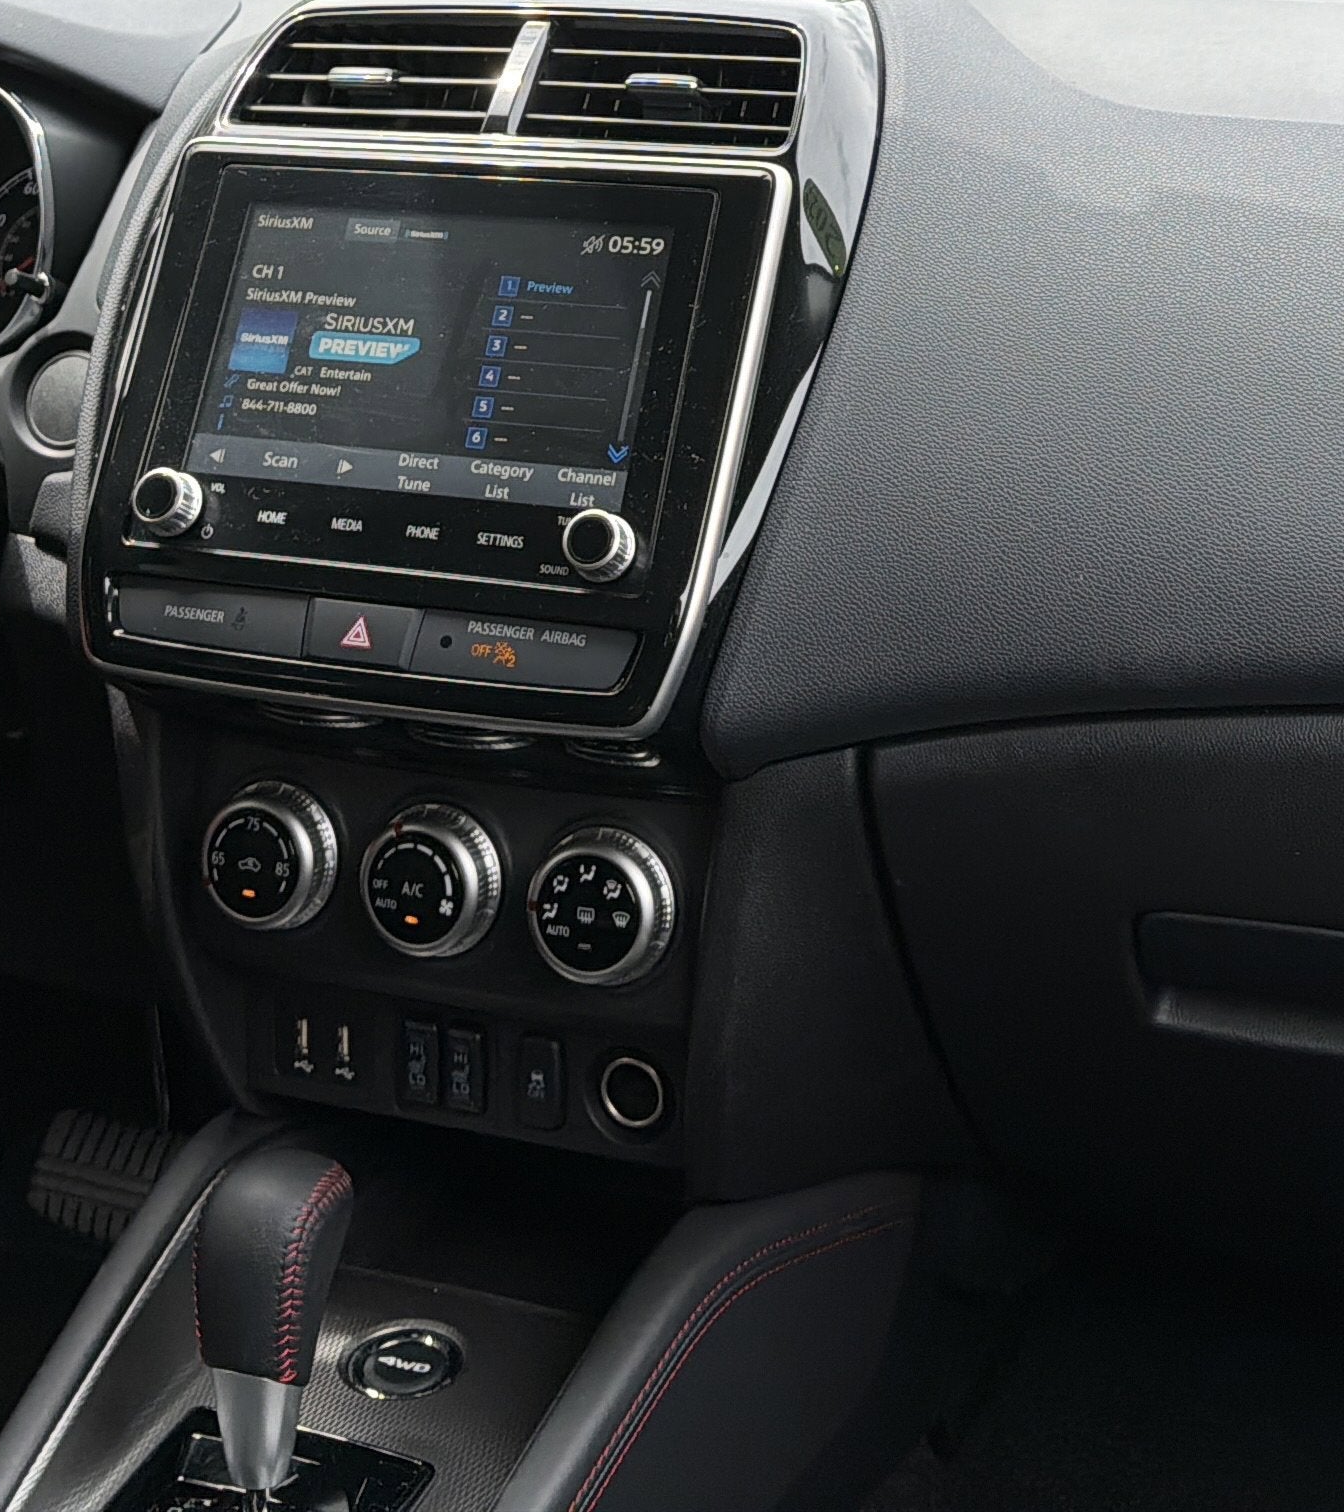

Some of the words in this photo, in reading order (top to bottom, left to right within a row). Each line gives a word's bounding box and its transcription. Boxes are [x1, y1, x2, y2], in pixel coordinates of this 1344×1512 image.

[258, 214, 314, 230] SiriusXM
[353, 223, 392, 236] Source
[608, 236, 665, 255] 05:59
[252, 264, 274, 279] CH
[276, 265, 285, 280] 1
[527, 281, 574, 295] Preview
[246, 287, 303, 304] SiriusXM
[305, 291, 357, 308] Preview
[324, 312, 415, 335] SIRIUSXM
[240, 332, 289, 345] SiriusXM
[318, 338, 411, 359] PREVIEW
[294, 365, 314, 377] CAT
[320, 367, 372, 382] Entertain
[247, 378, 277, 392] Great
[279, 381, 309, 395] Offer
[310, 383, 342, 397] Now!
[241, 398, 317, 416] 844-711-8800
[263, 451, 298, 469] Scan
[398, 454, 440, 470] Direct
[470, 460, 534, 481] Category
[558, 468, 617, 487] Channel
[210, 482, 226, 494] VOL
[397, 476, 431, 492] Tune
[485, 484, 510, 500] List
[569, 492, 595, 508] List
[257, 509, 288, 525] HOME
[331, 516, 363, 532] MEDIA
[406, 524, 440, 540] PHONE
[476, 531, 524, 549] SETTINGS
[539, 563, 570, 576] SOUND
[164, 605, 225, 623] PASSENGER
[467, 620, 535, 641] PASSENGER
[541, 629, 587, 647] AIRBAG
[471, 643, 493, 657] OFF
[246, 816, 260, 832] 75
[211, 851, 226, 866] 65
[275, 862, 290, 877] 85
[373, 878, 389, 889] OFF
[401, 880, 424, 898] A/C
[375, 896, 397, 910] AUTO
[546, 923, 570, 938] AUTO
[378, 1356, 431, 1373] 4WD
